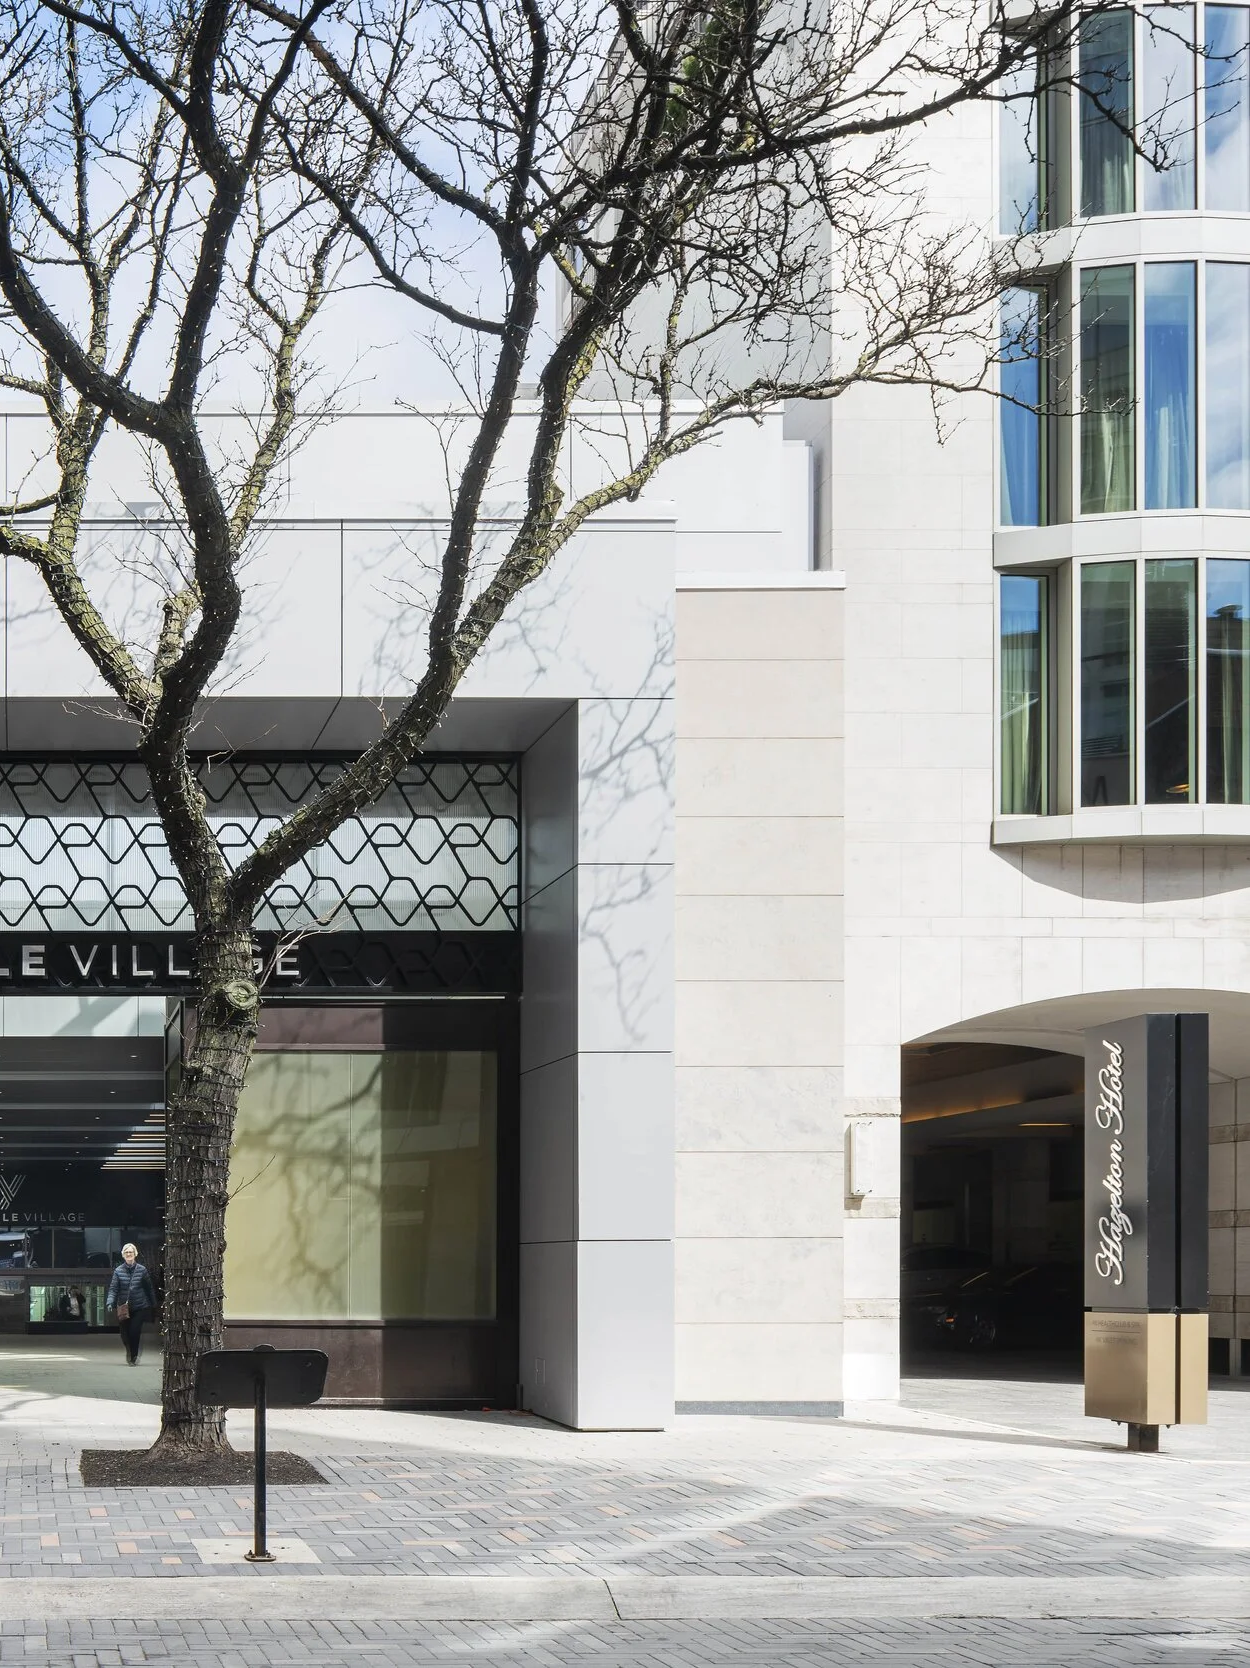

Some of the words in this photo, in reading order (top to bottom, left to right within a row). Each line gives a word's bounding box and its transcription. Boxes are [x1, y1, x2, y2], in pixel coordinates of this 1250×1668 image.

[69, 944, 300, 977] VILLE
[1095, 1039, 1124, 1135] Hotel
[24, 1212, 86, 1222] VILLAGE
[1095, 1138, 1134, 1285] Hazelton
